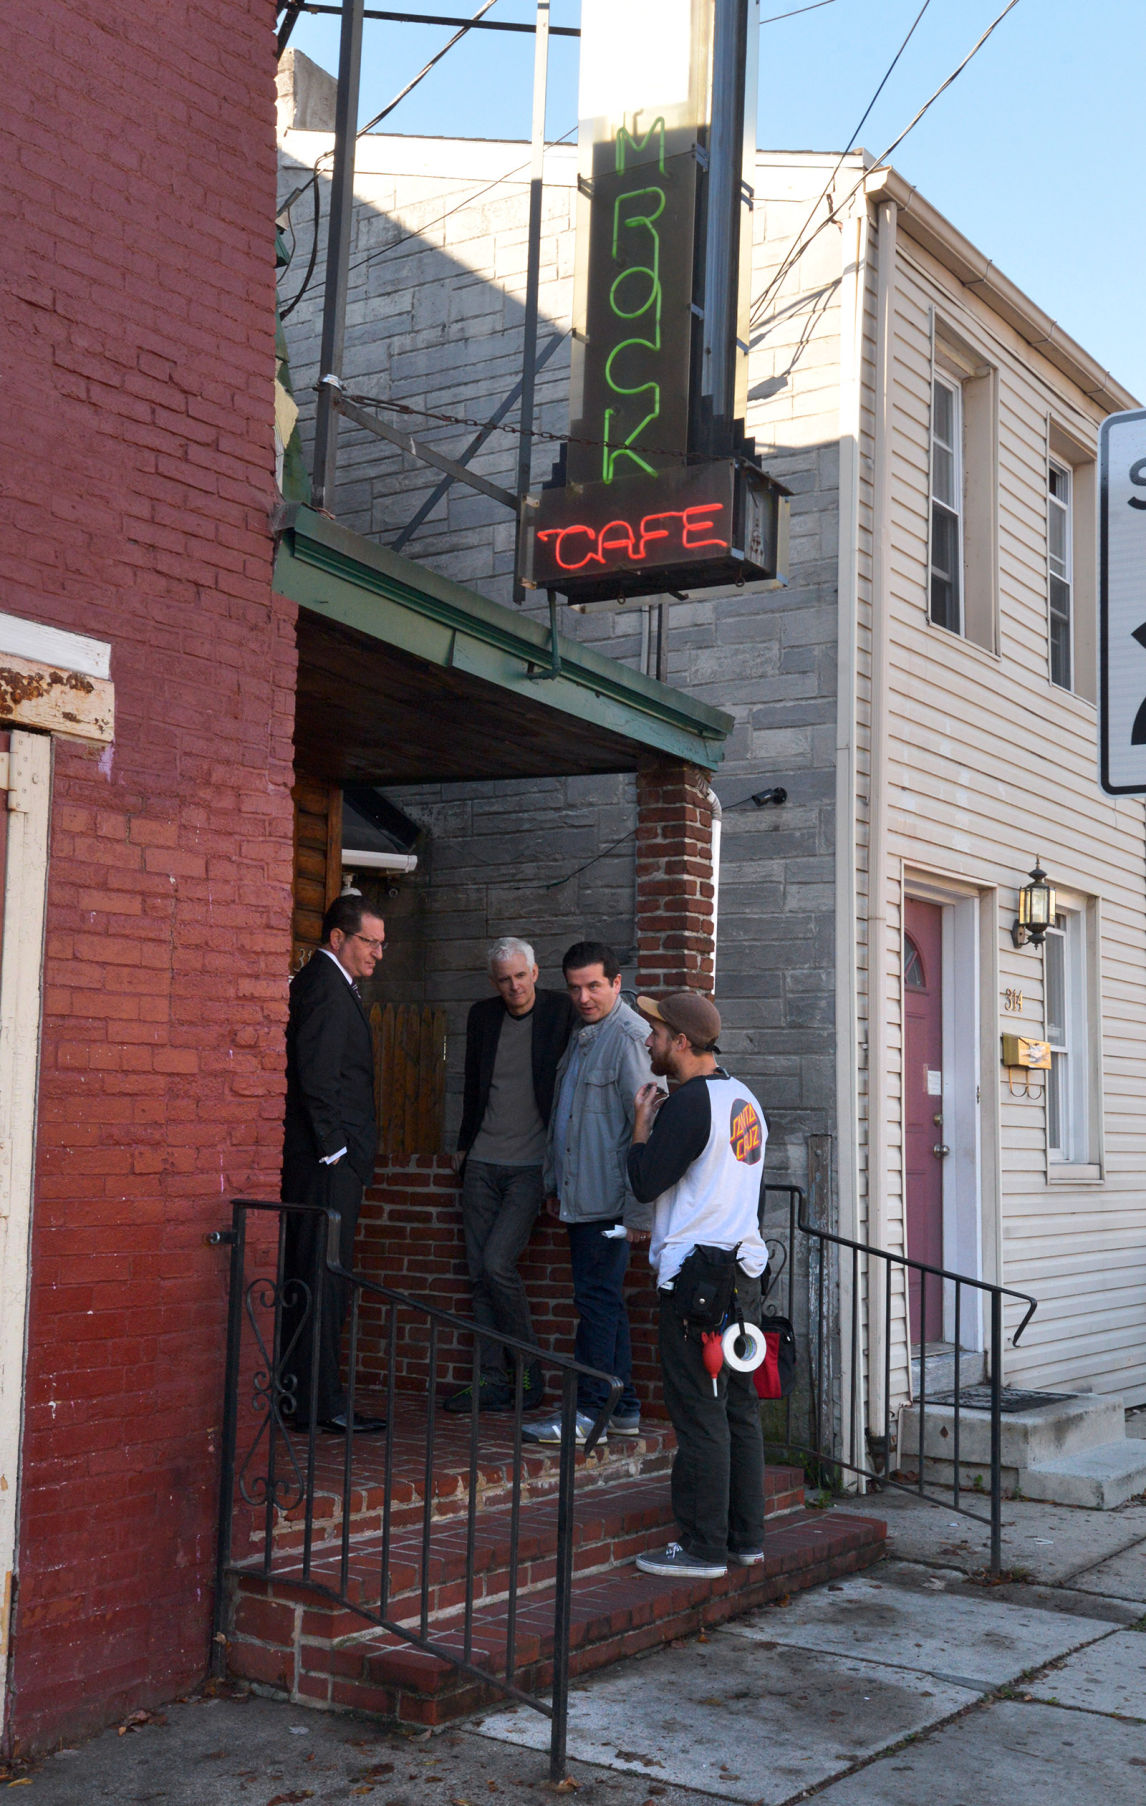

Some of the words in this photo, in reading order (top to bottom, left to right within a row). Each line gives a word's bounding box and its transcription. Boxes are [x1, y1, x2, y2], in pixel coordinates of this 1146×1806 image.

[537, 503, 728, 569] CAFE
[1004, 988, 1023, 1012] 314
[730, 1102, 757, 1143] SANTA
[736, 1124, 760, 1161] CRUZ
